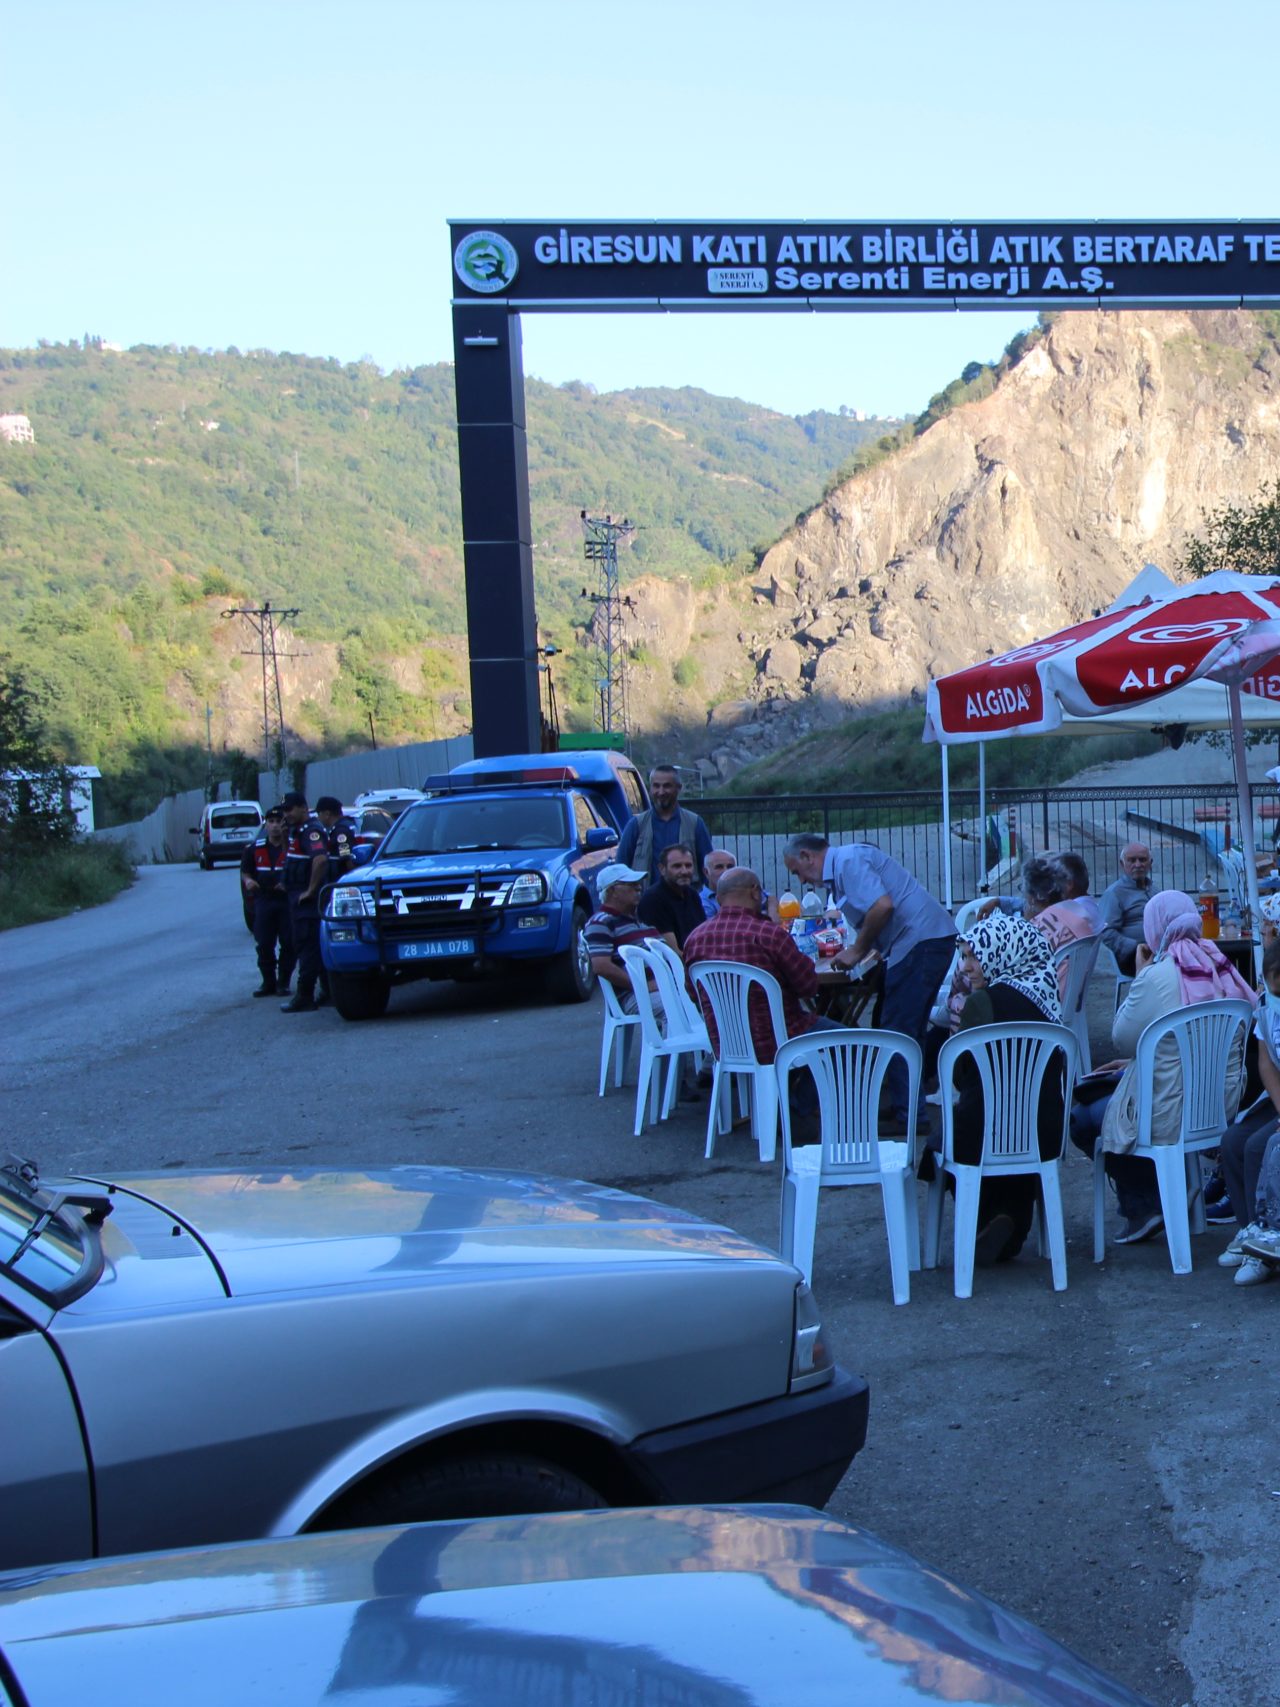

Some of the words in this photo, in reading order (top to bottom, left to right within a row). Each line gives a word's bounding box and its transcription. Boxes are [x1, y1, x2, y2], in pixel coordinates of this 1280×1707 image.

[534, 228, 682, 264] GİRESUN
[692, 235, 767, 263] KATI
[776, 235, 853, 263] ATIK
[862, 228, 979, 263] BİRLİĞİ
[989, 235, 1064, 263] ATIK
[1072, 234, 1235, 263] BERTARAF
[774, 266, 910, 290] Serenti
[922, 266, 1030, 295] Enerji
[1041, 266, 1115, 293] A.Ş.
[403, 944, 418, 957] 28
[423, 942, 444, 955] JAA
[448, 940, 469, 953] 078
